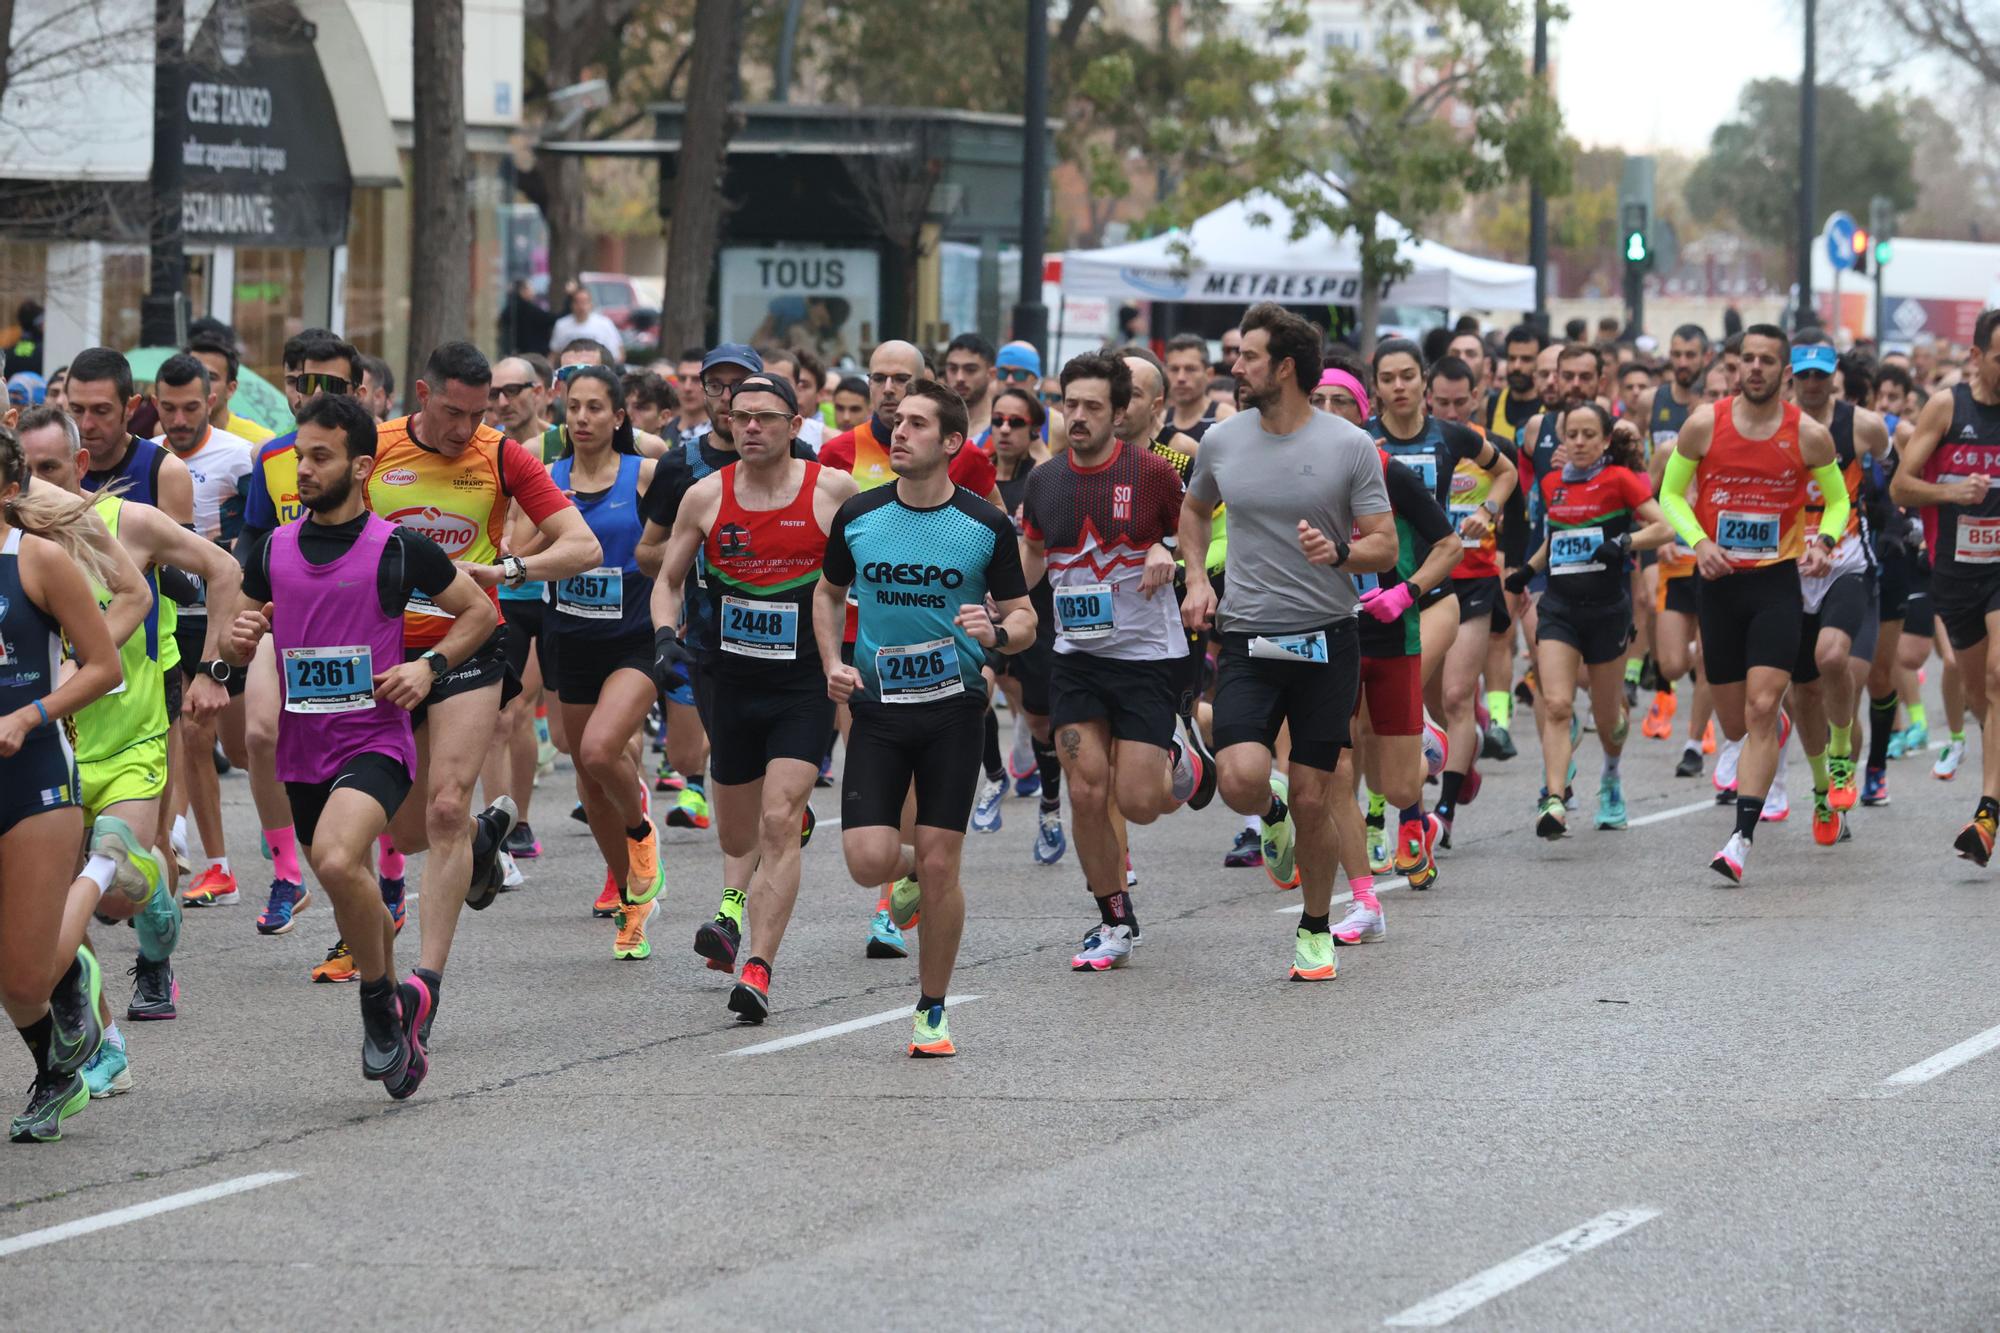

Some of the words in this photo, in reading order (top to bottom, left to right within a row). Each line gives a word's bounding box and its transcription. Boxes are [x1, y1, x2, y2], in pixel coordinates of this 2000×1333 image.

[187, 82, 219, 124] CHE
[221, 84, 272, 127] TANGO
[182, 192, 275, 233] ESTAURANTE
[756, 258, 845, 289] TOUS
[1203, 271, 1397, 299] METAESPOT
[1114, 486, 1131, 503] SO
[1725, 520, 1770, 541] 2346
[1556, 536, 1592, 556] 2154
[863, 562, 964, 590] CRESPO
[877, 590, 947, 609] RUNNERS
[731, 607, 783, 636] 2448
[296, 659, 356, 687] 2361
[886, 651, 945, 680] 2426
